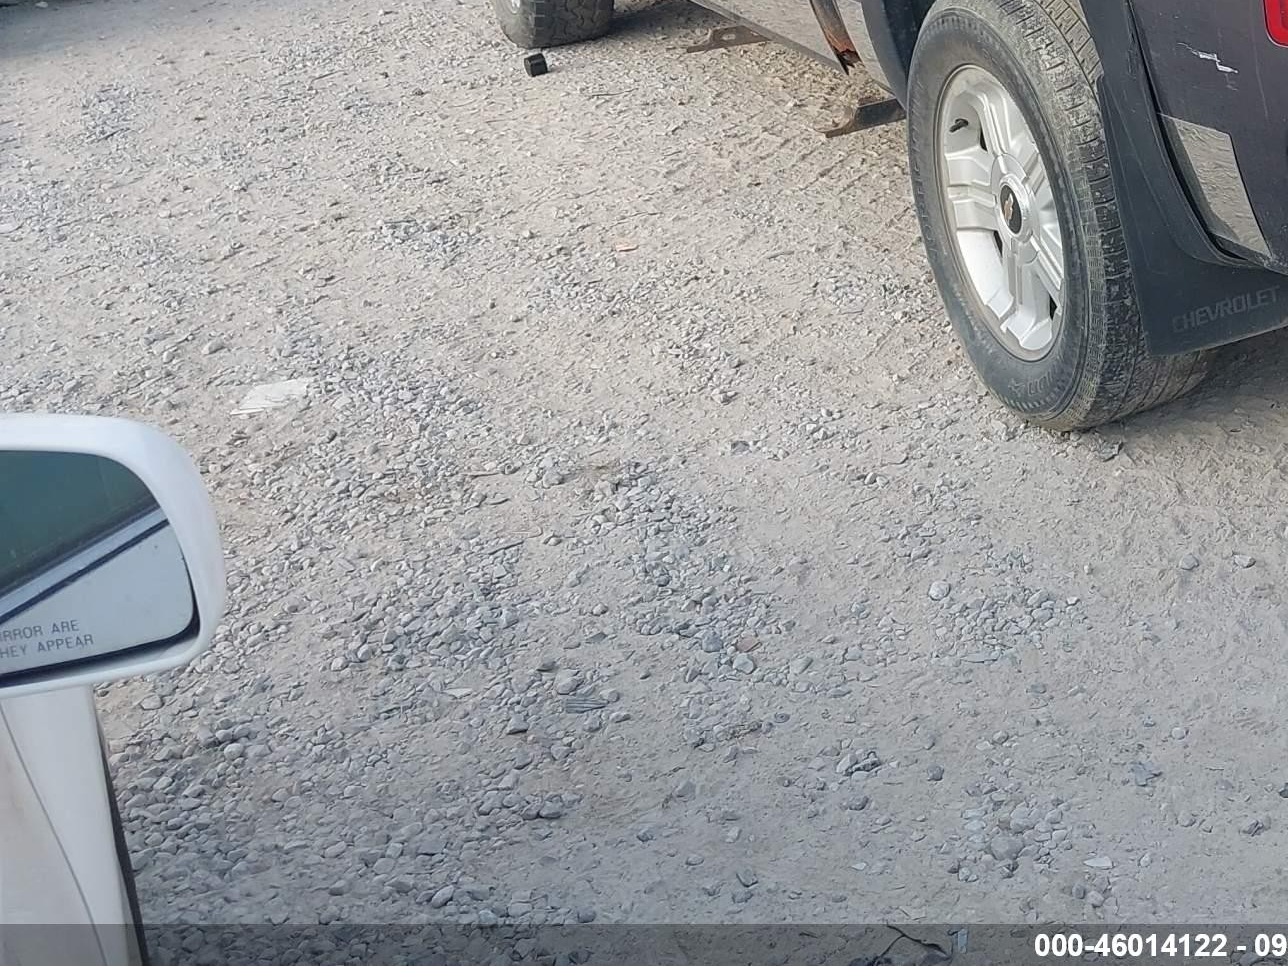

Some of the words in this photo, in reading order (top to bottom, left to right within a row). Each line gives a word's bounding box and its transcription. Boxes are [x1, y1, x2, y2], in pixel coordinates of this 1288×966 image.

[1172, 284, 1280, 333] CHEVROLET
[52, 619, 80, 634] ARE
[37, 633, 95, 653] APPEAR
